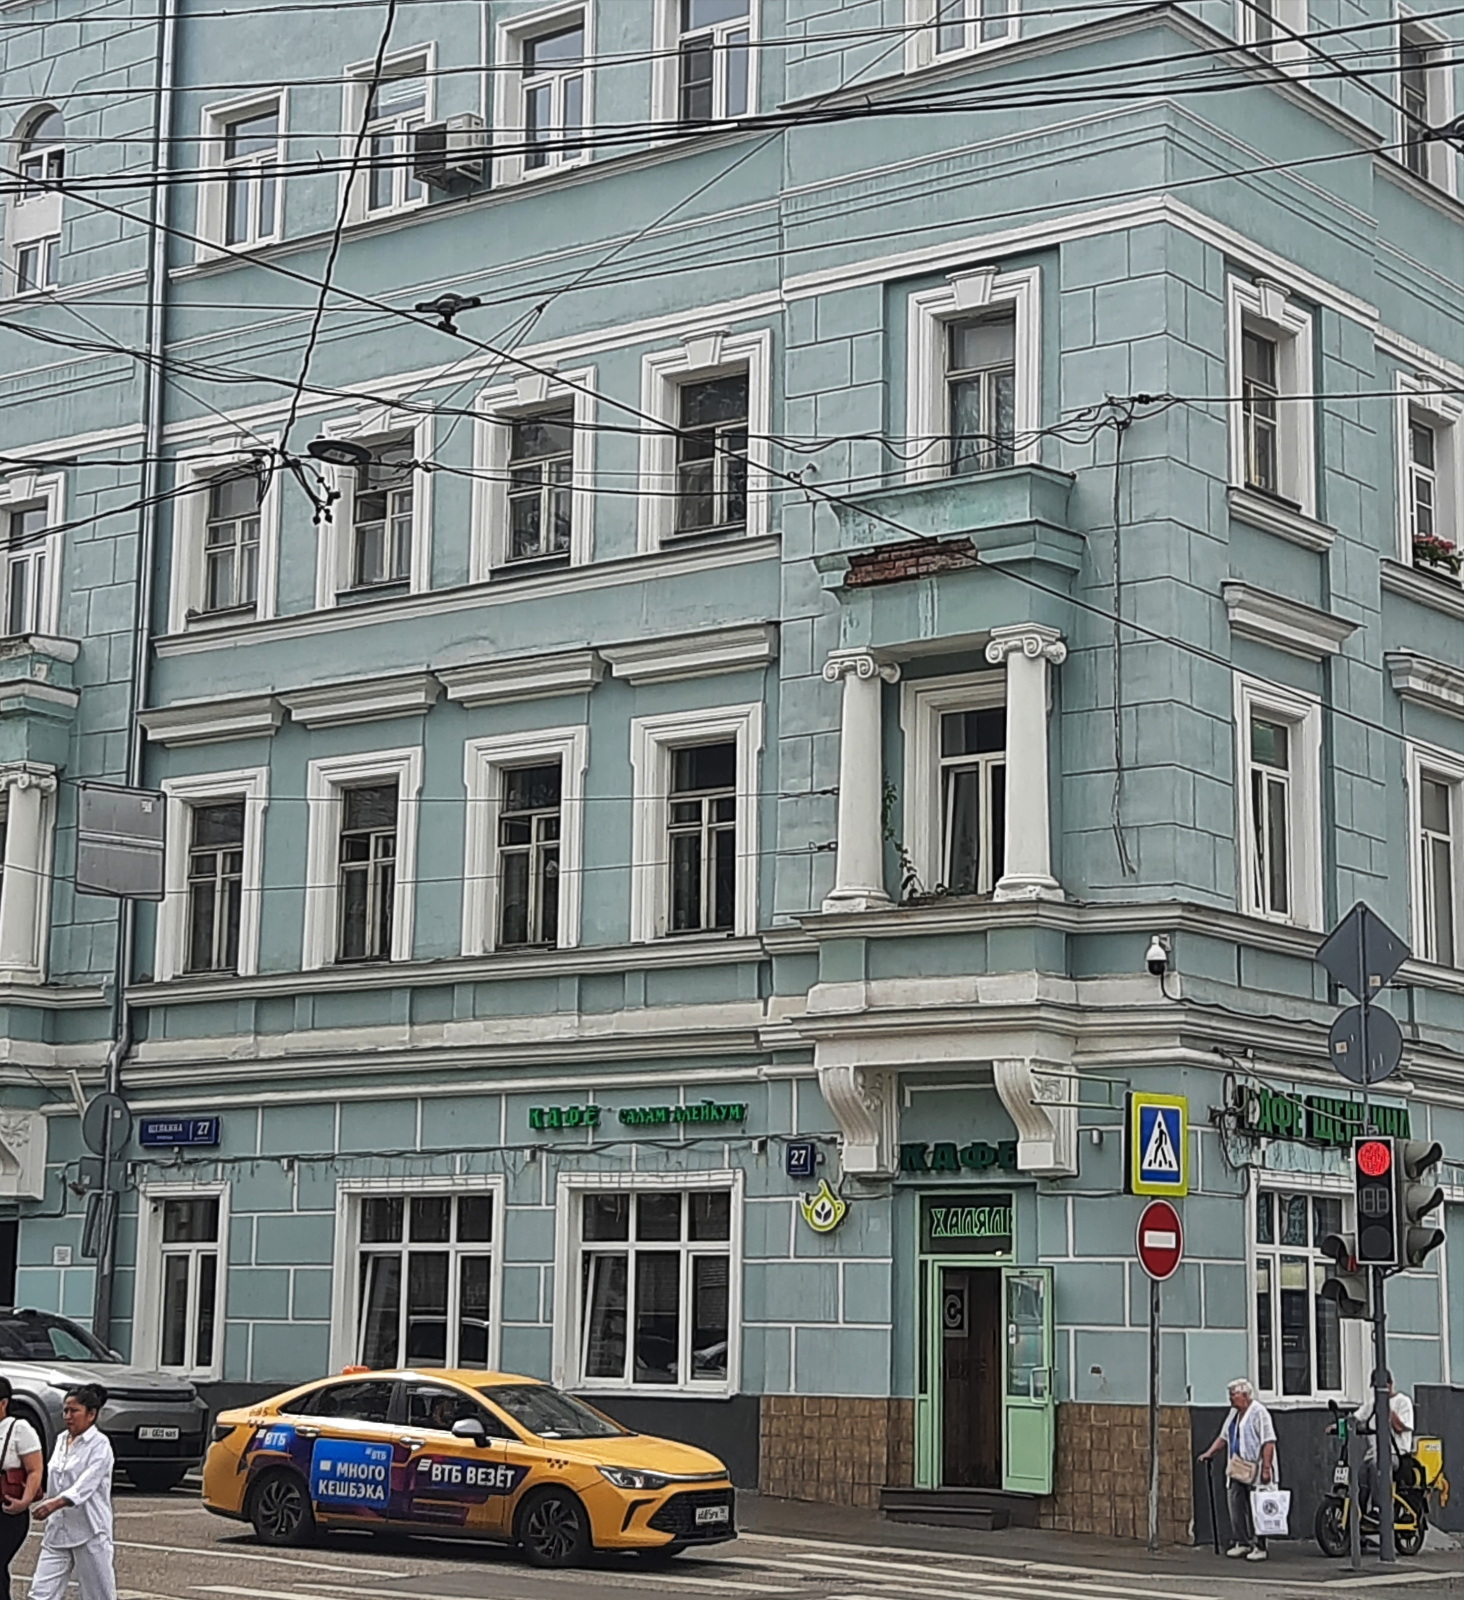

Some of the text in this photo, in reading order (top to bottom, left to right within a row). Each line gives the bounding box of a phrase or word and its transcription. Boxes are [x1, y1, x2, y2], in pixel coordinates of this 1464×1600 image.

[529, 1099, 745, 1129] КАФЕ САЛАМ АЛЕЙКУМ
[1241, 1086, 1303, 1137] АФЕ
[197, 1122, 210, 1135] 27
[790, 1150, 806, 1165] 27
[899, 1141, 1017, 1171] КАФЕ
[264, 1432, 287, 1446] ВТБ
[371, 1450, 387, 1460] ВТБ
[336, 1462, 386, 1481] МНОГО
[431, 1464, 516, 1489] ВТБ ВЕЗЁТ
[318, 1479, 385, 1500] КЕШБЭКА
